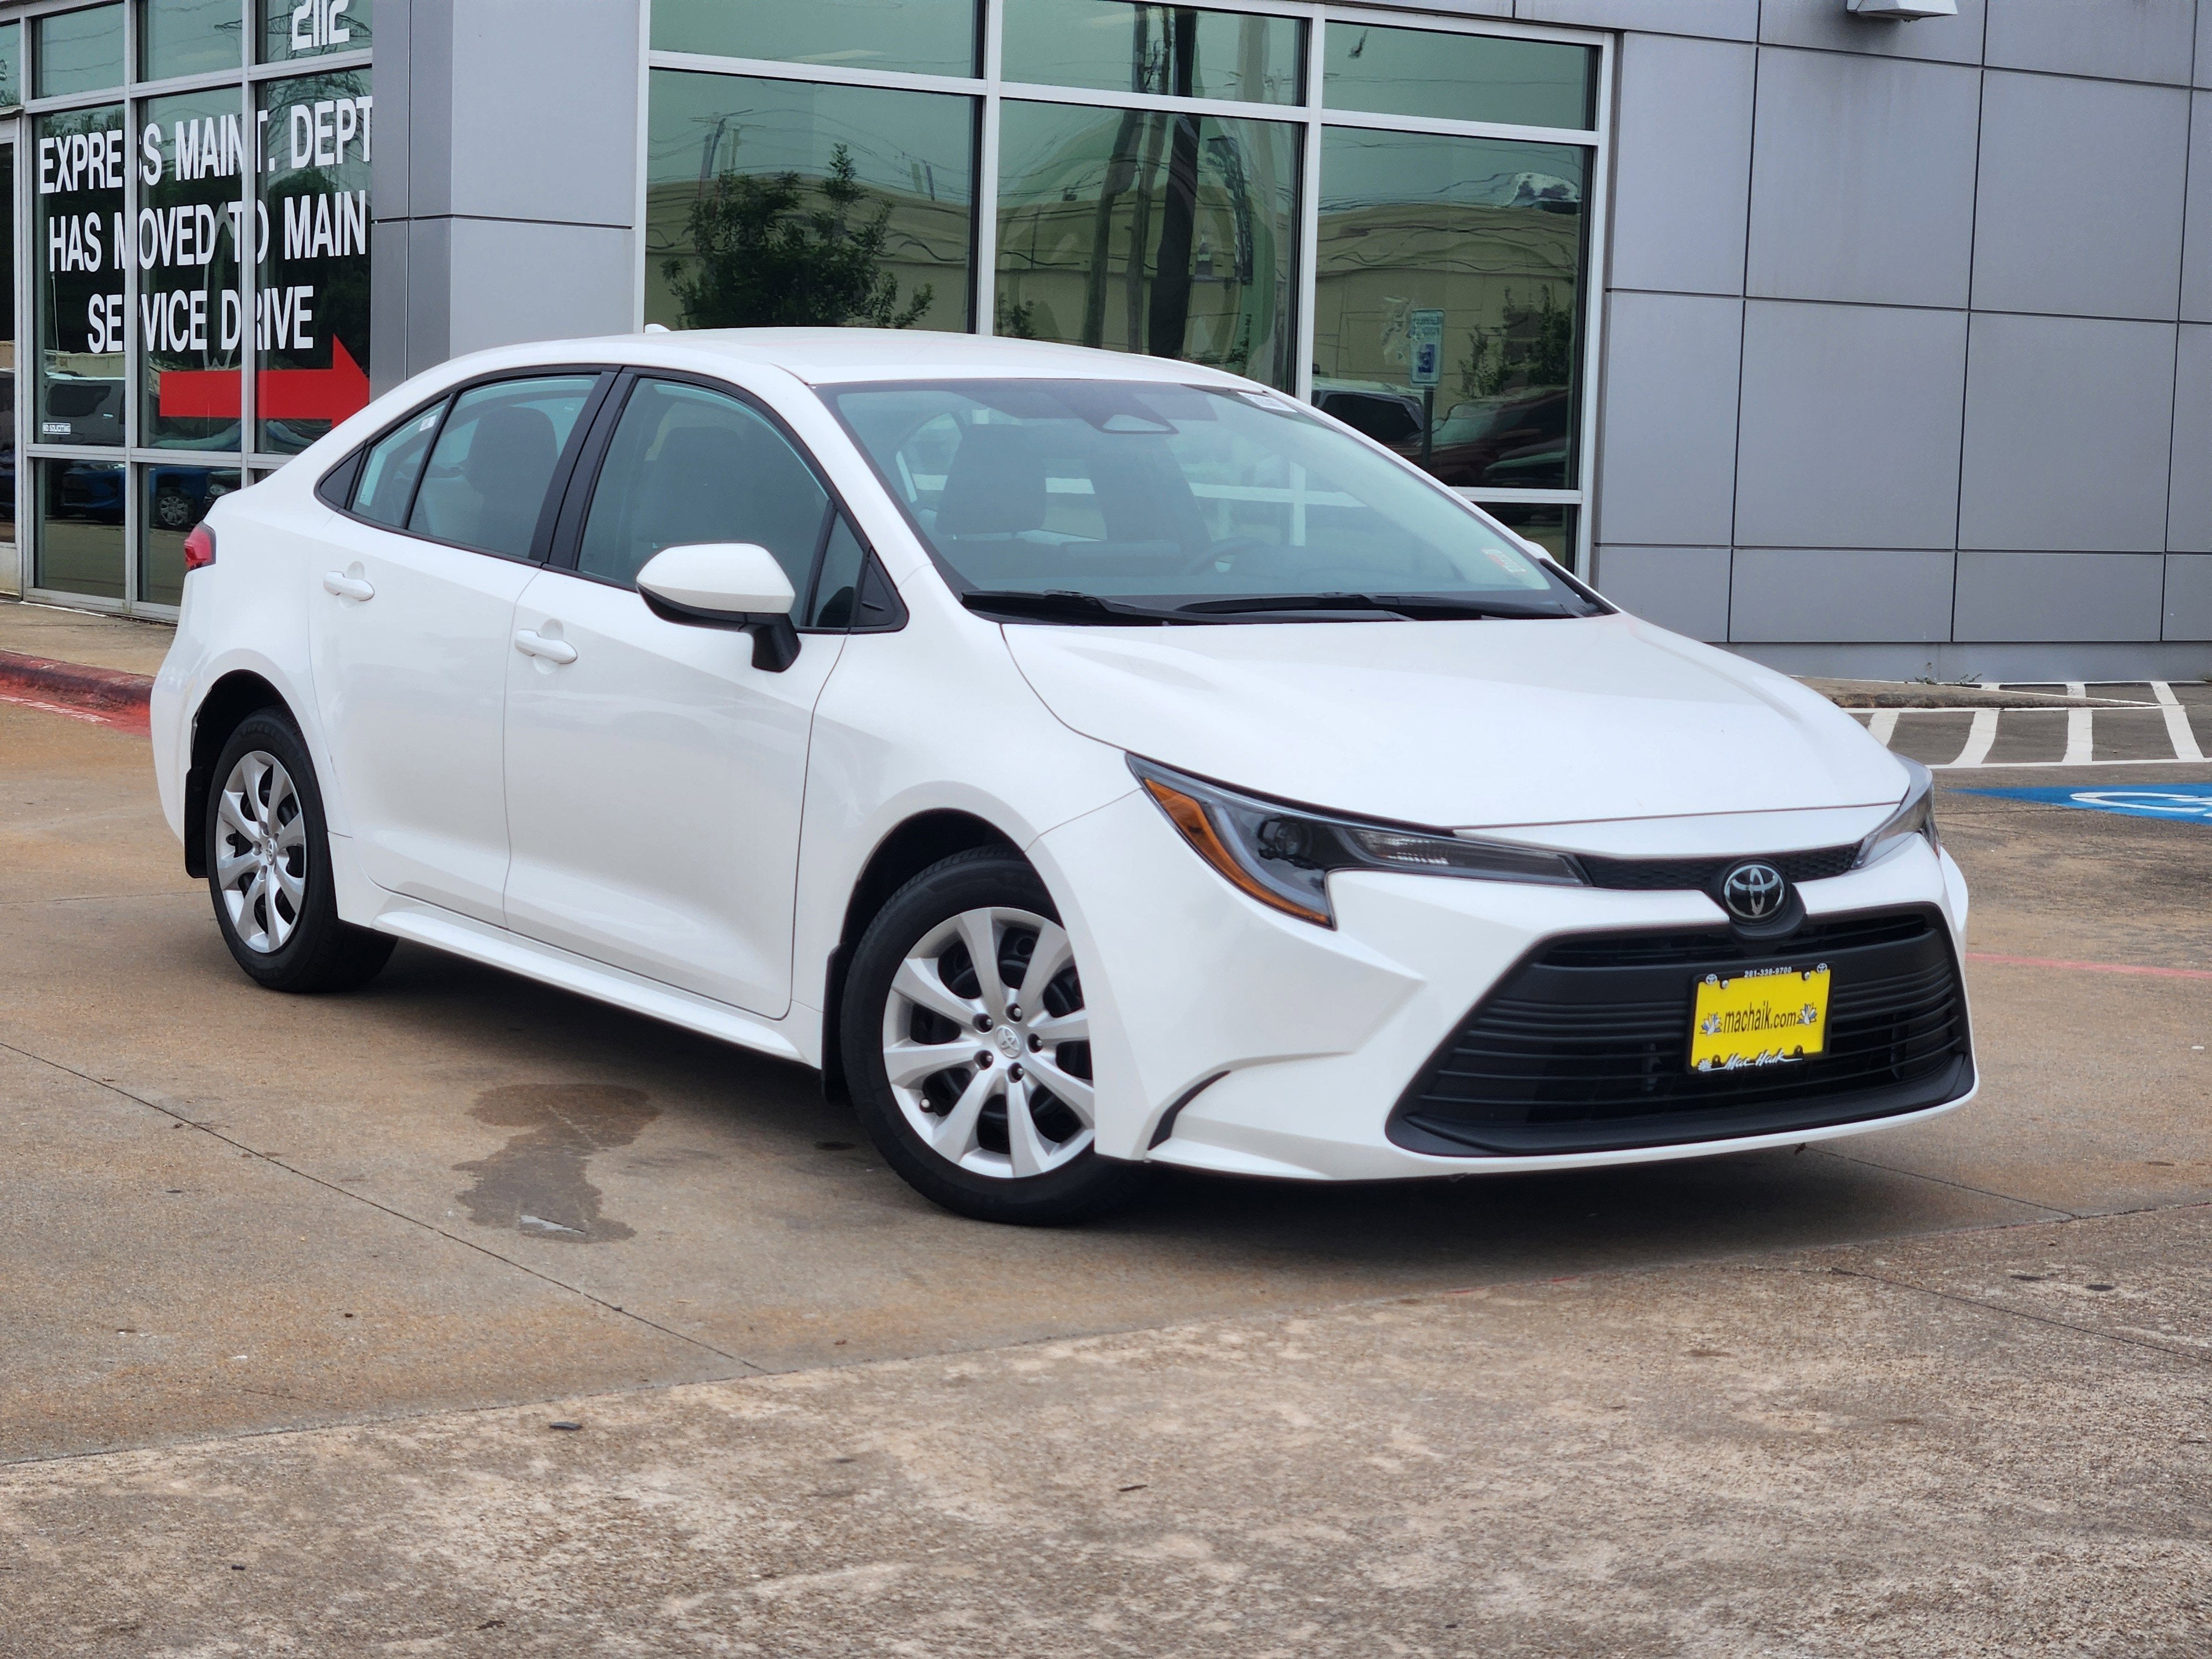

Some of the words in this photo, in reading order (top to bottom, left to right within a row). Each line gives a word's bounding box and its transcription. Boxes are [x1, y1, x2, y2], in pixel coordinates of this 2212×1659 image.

[39, 123, 162, 194] EXPRES
[291, 96, 373, 169] DEPT
[50, 212, 102, 272] HAS
[284, 190, 366, 260] MAIN
[87, 289, 207, 353] SEVICE
[221, 285, 314, 350] DIVE
[1744, 966, 1792, 978] 281-338-9700
[1723, 1000, 1797, 1033] machaik.com
[1713, 1052, 1755, 1071] Mac
[1755, 1048, 1802, 1066] Haik
